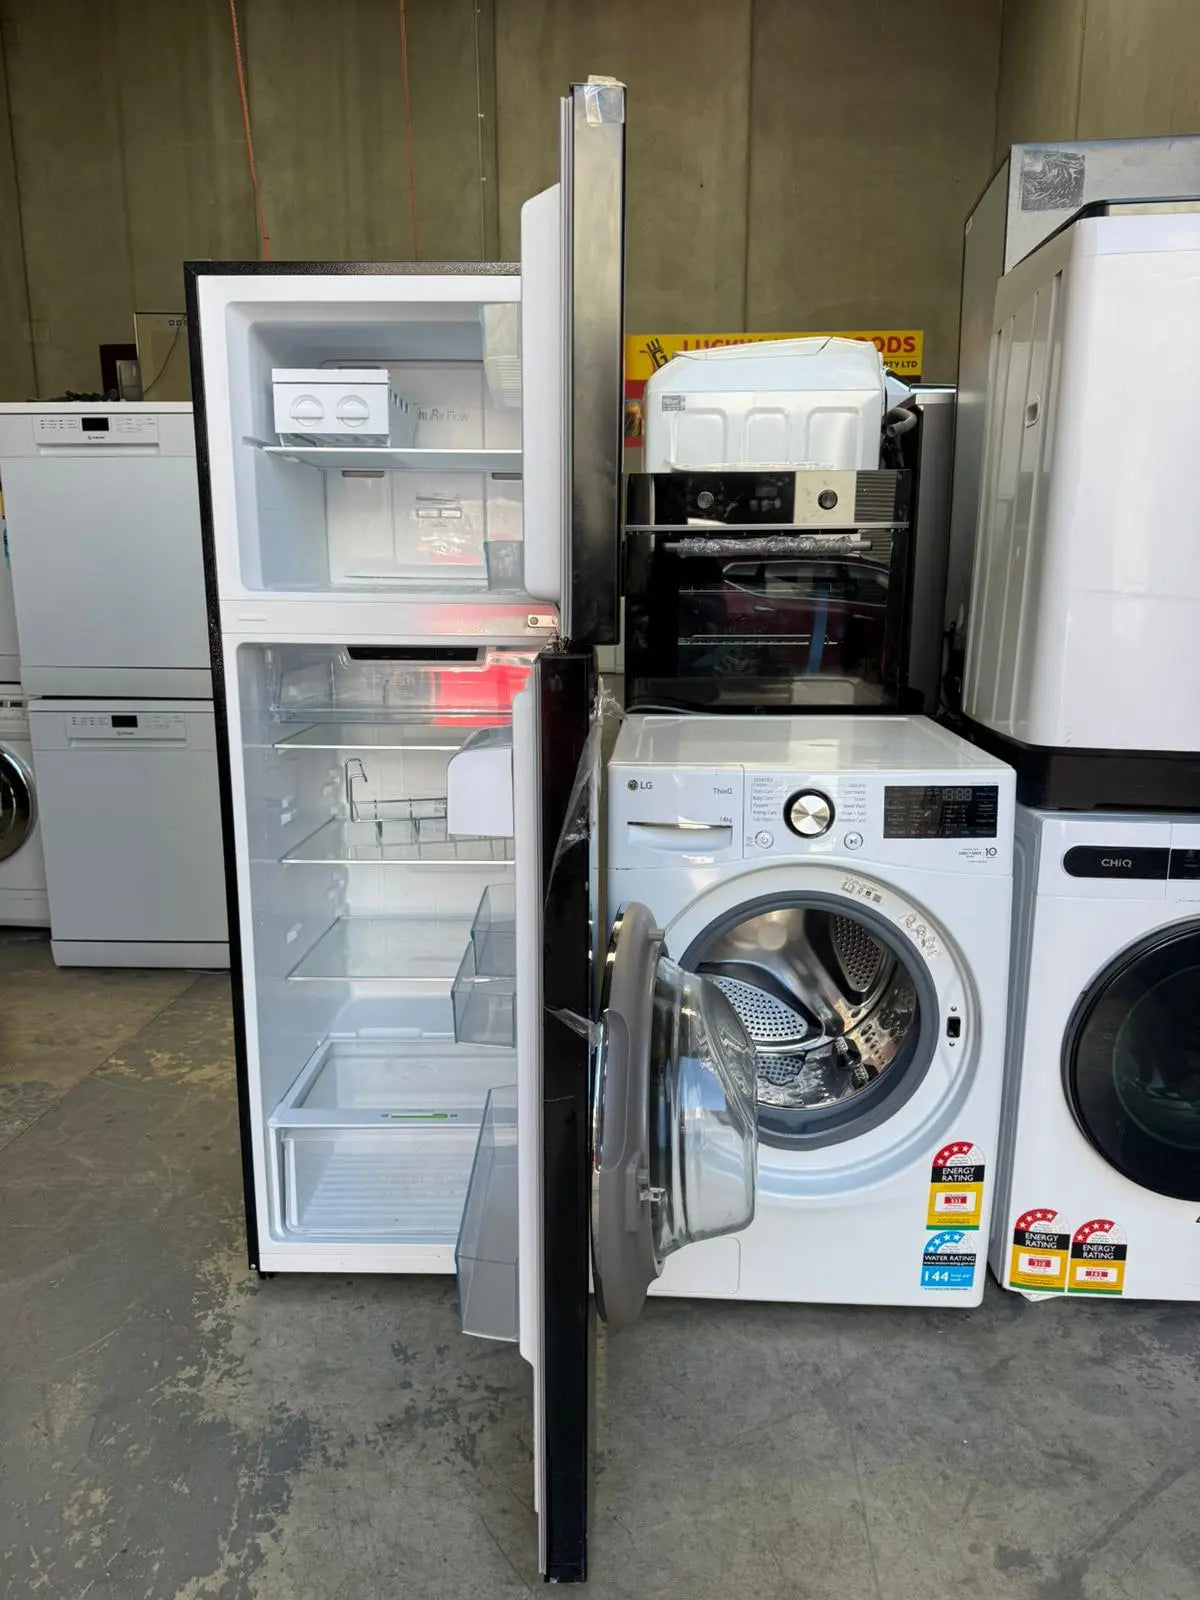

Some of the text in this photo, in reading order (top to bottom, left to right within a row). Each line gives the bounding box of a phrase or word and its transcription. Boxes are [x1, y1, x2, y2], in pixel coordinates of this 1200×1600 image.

[901, 360, 918, 368] LTD
[640, 781, 653, 790] LG
[713, 787, 733, 795] ThinQ
[1101, 858, 1132, 868] CHiQ
[942, 1167, 975, 1175] ENERGY
[942, 1174, 974, 1182] RATING
[1025, 1232, 1059, 1242] ENERGY
[1025, 1240, 1057, 1249] RATING
[1082, 1244, 1116, 1252] ENERGY
[1082, 1252, 1114, 1260] RATING
[925, 1270, 949, 1282] 144
